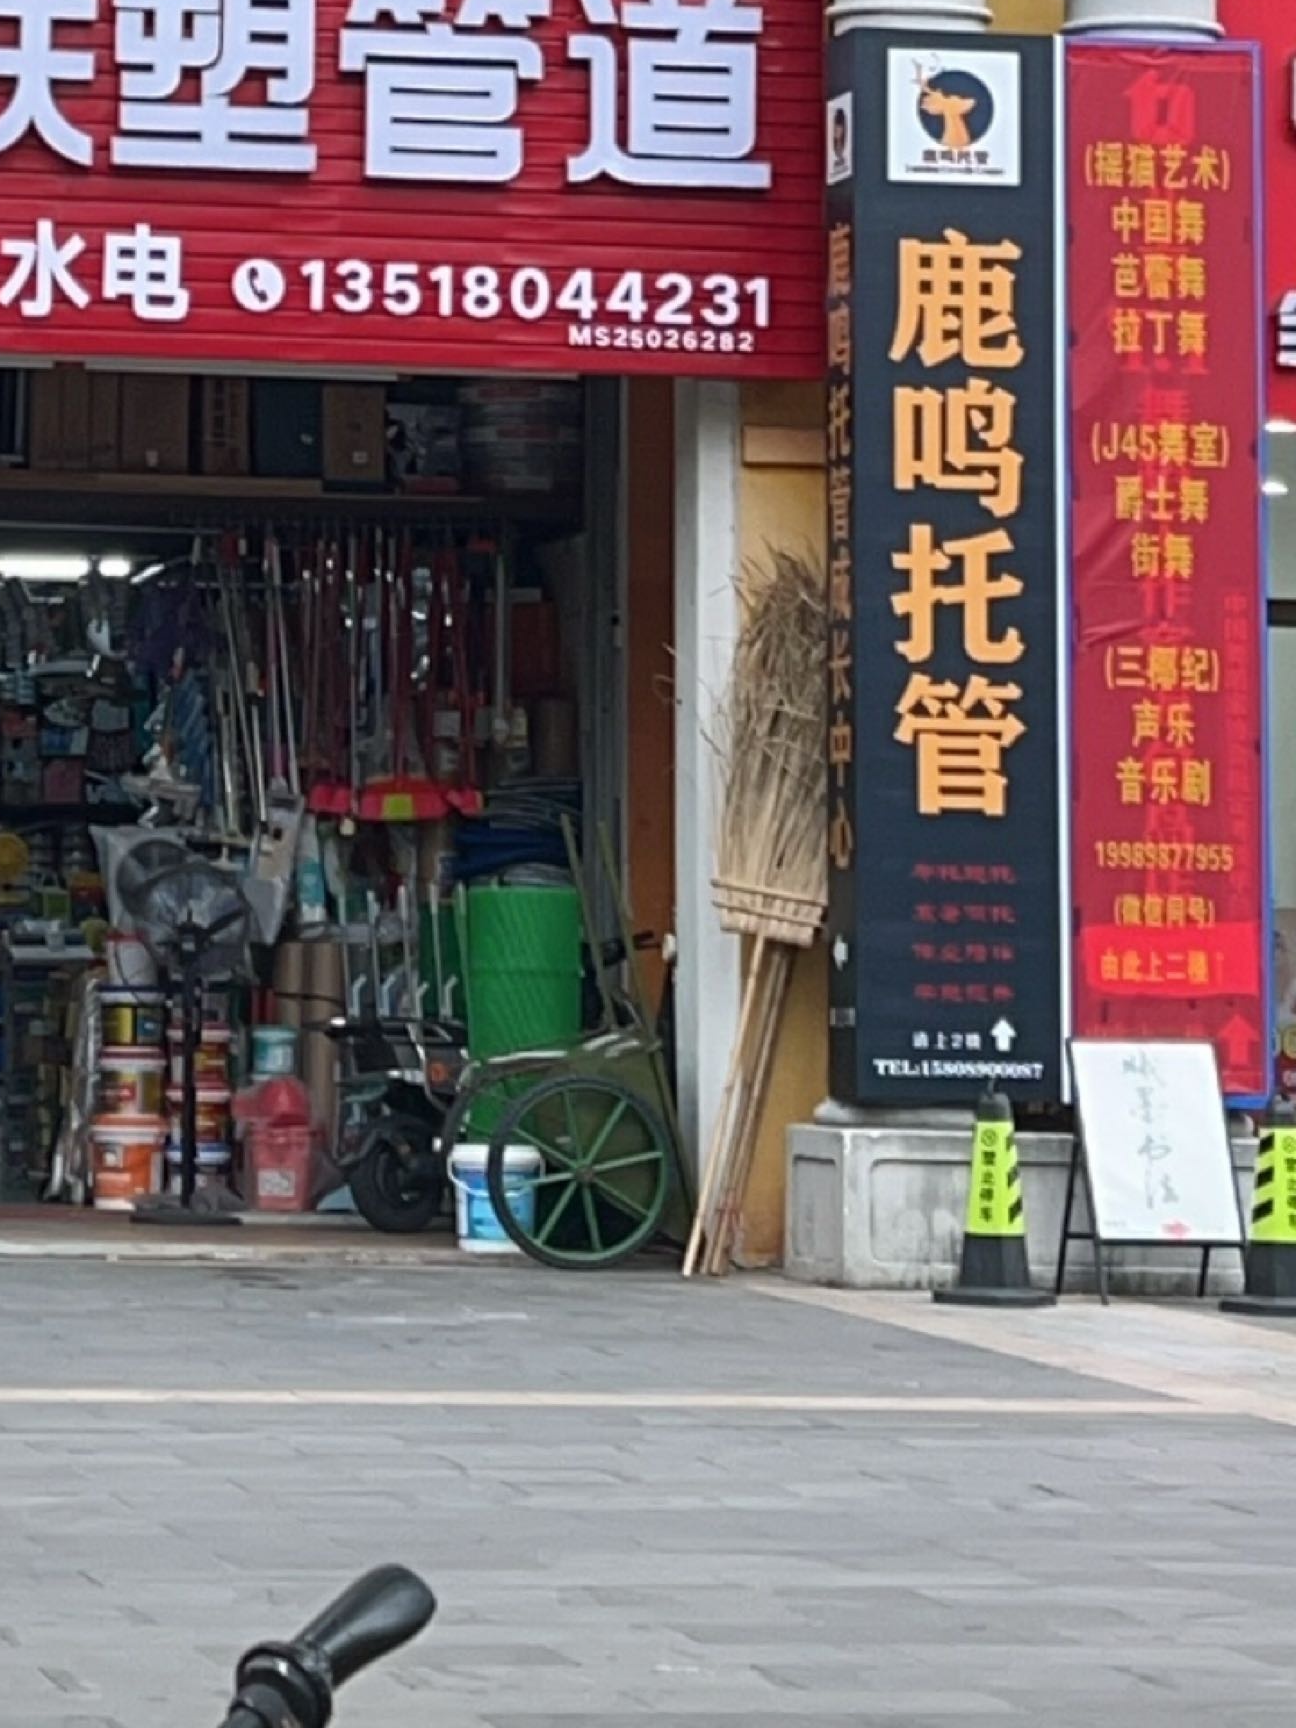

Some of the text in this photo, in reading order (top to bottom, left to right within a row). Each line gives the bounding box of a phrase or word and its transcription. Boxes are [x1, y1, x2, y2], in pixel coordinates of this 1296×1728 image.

[1111, 196, 1206, 245] 中国舞
[301, 259, 770, 329] 13518044231
[1111, 252, 1206, 301] 芭蕾舞
[567, 324, 755, 353] MS25026282
[1112, 308, 1207, 355] 拉丁舞
[888, 227, 1028, 818] 鹿鸣托管
[1131, 532, 1194, 579] 街舞
[1132, 699, 1196, 749] 声乐
[1116, 756, 1212, 808] 音乐剧
